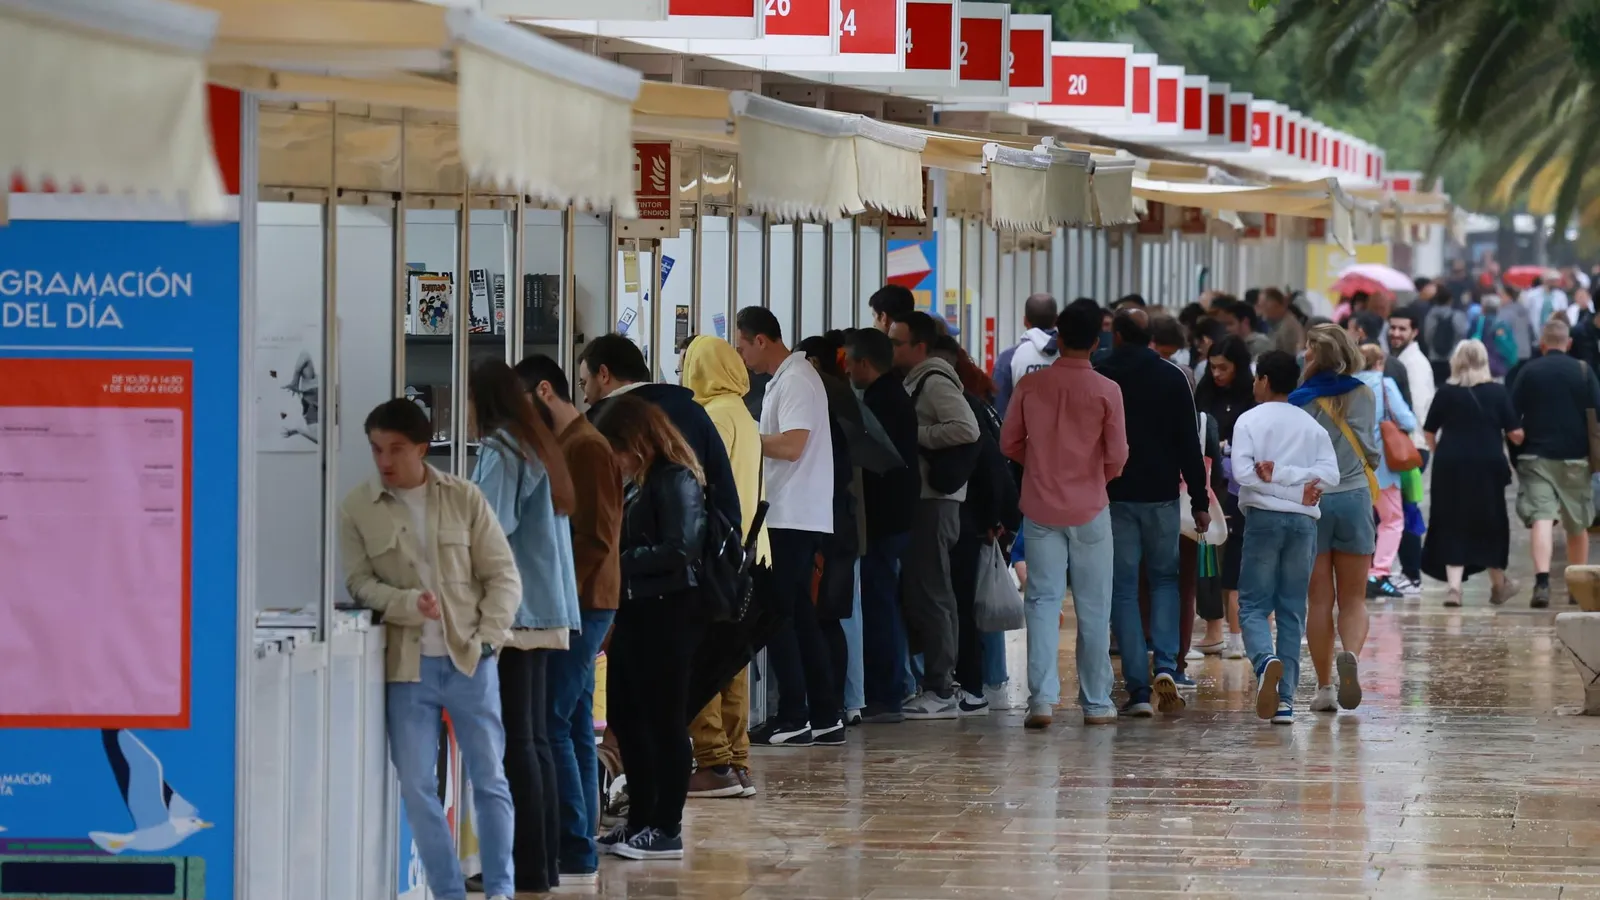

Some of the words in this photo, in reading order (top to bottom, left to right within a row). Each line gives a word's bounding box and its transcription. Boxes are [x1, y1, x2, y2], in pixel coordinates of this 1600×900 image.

[765, 0, 791, 17] 26
[1068, 74, 1088, 95] 20
[3, 301, 57, 328] DEL
[66, 297, 124, 329] DÍA
